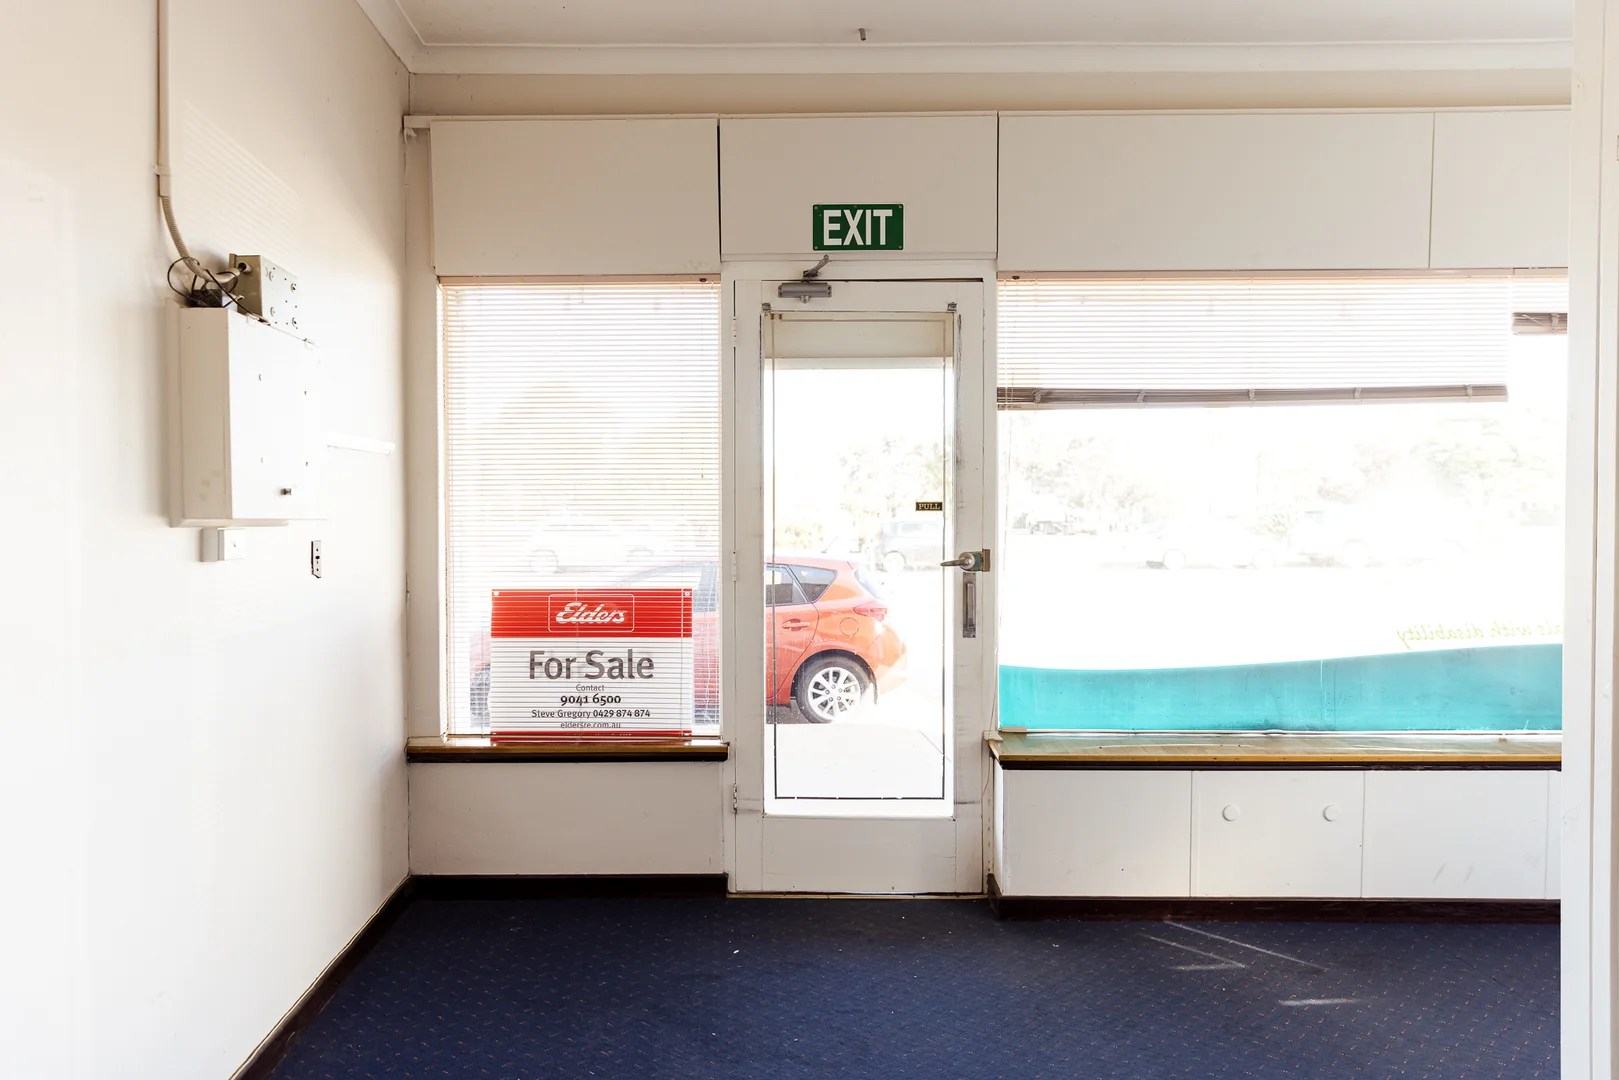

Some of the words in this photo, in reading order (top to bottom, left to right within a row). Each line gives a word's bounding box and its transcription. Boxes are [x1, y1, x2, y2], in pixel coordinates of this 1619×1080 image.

[823, 209, 893, 246] EXIT
[555, 601, 628, 625] Elders
[529, 650, 577, 680] For
[584, 648, 655, 680] Sale
[575, 683, 605, 692] Contact
[560, 694, 589, 707] 9041
[592, 693, 621, 706] 6500
[531, 709, 555, 718] Steve
[557, 709, 591, 721] Gregory
[592, 709, 614, 718] 0429
[616, 709, 632, 718] 874
[634, 709, 651, 718] 874
